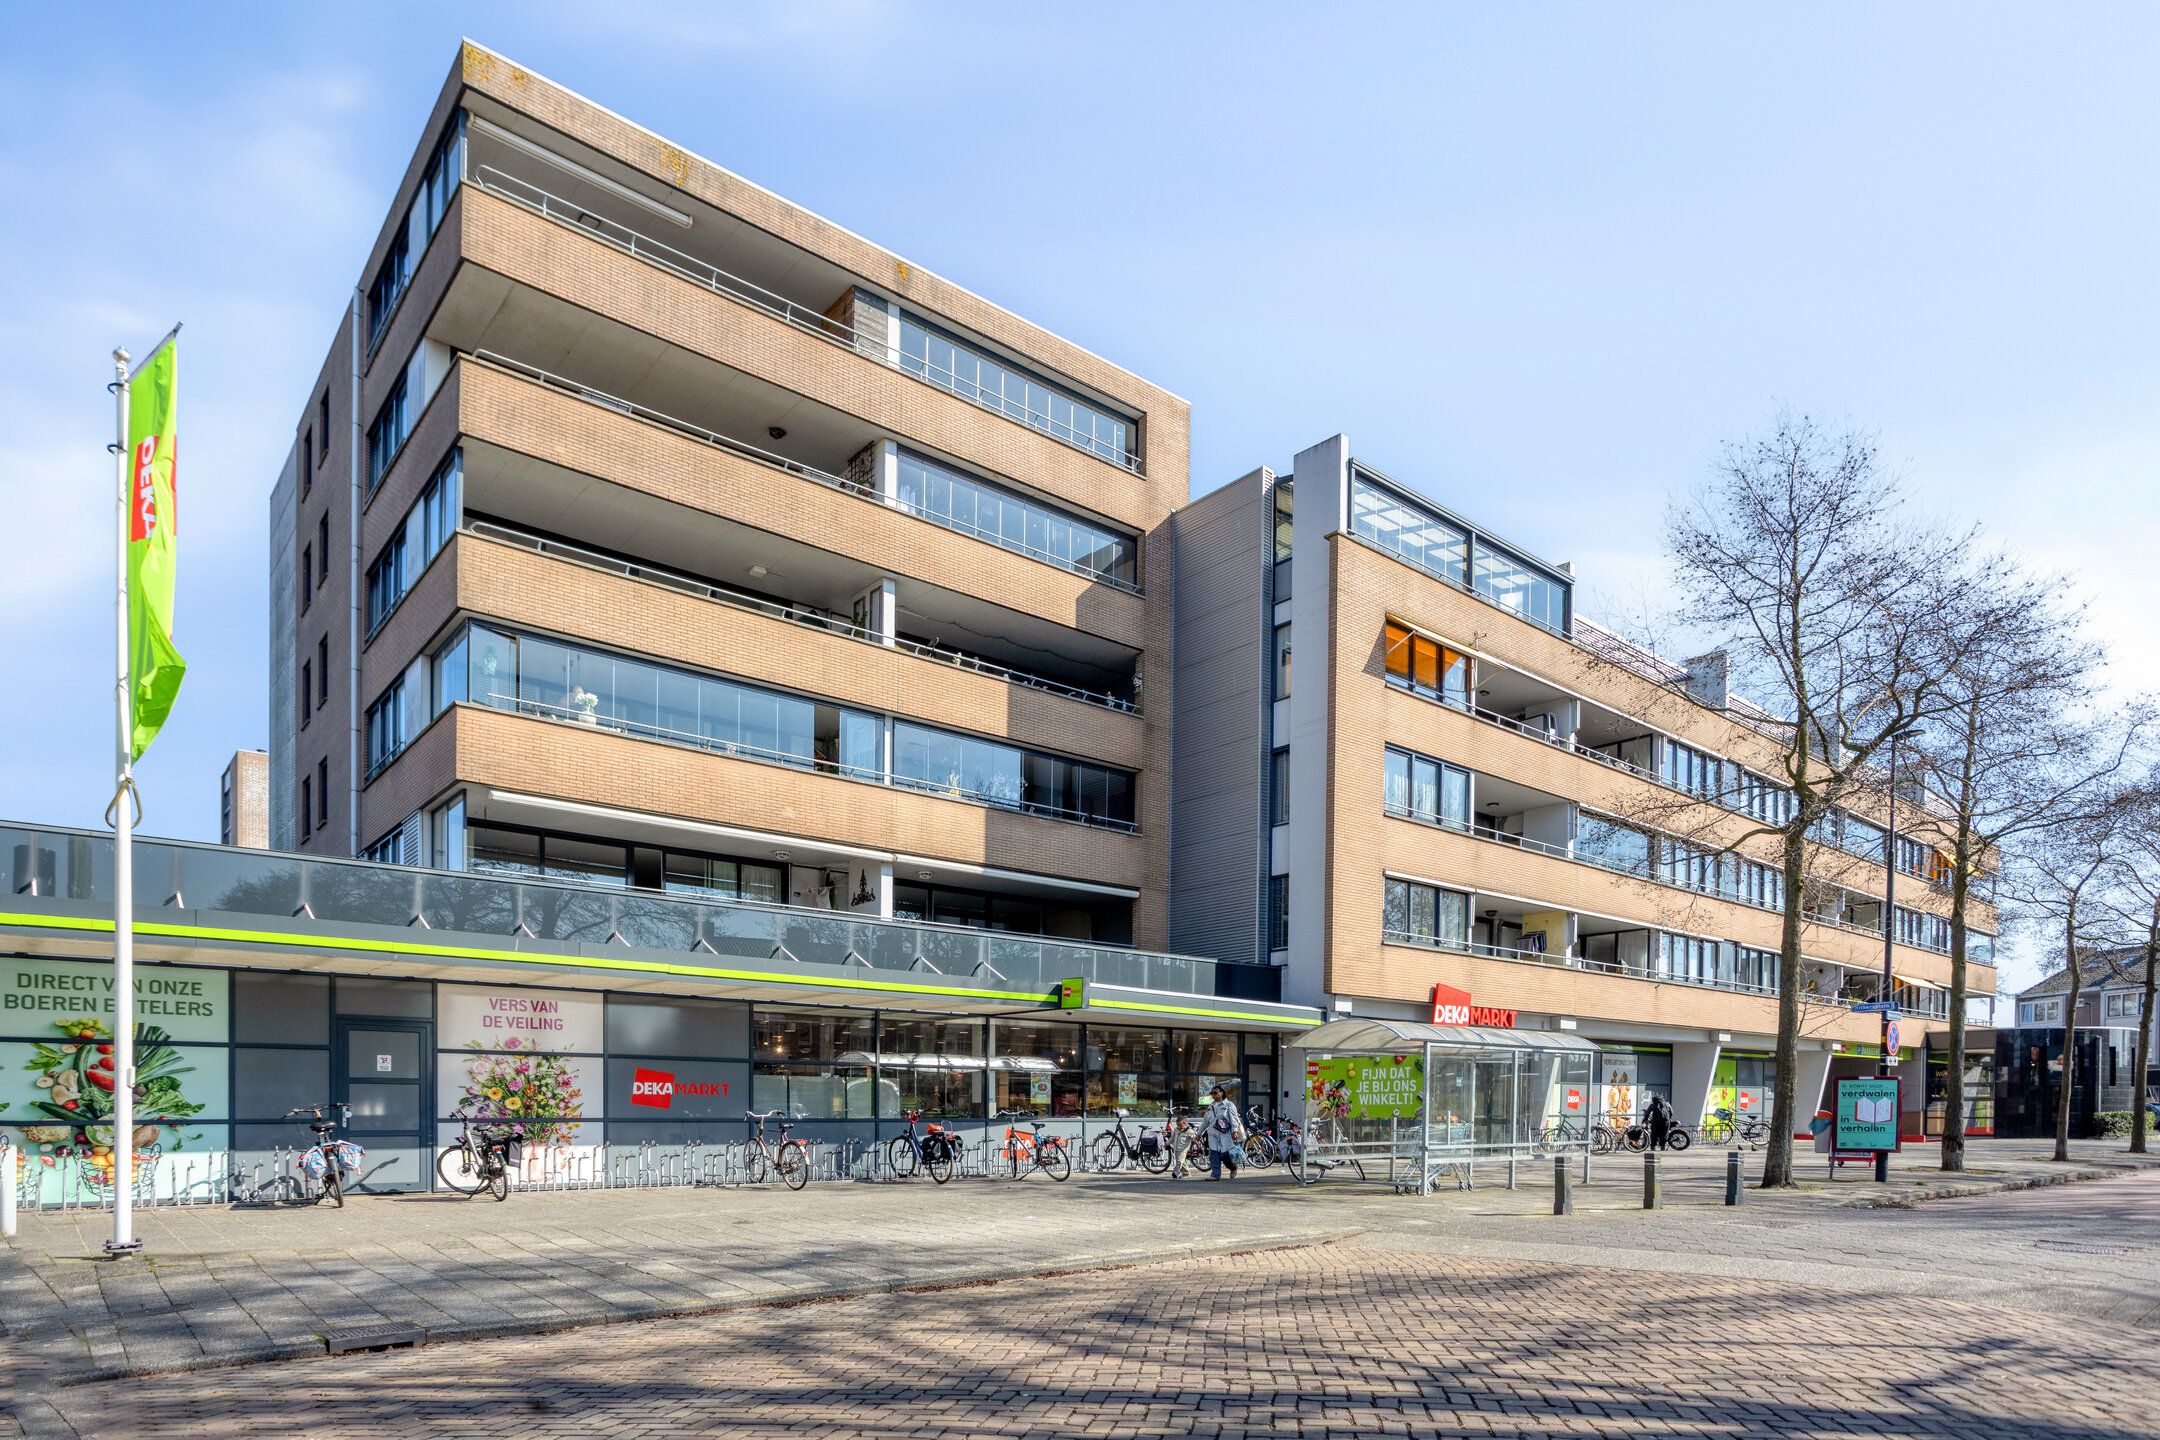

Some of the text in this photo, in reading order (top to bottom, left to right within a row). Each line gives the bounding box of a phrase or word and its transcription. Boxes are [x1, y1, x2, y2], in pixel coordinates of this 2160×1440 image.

[16, 972, 204, 996] DIRECT VN ONZE
[3, 993, 97, 1012] BOEREN
[136, 999, 214, 1016] TELERS
[488, 998, 558, 1013] VERS VAN
[482, 1015, 563, 1031] DE VEILING
[1362, 1067, 1411, 1080] FIJN DAT
[631, 1081, 730, 1097] DEKAMARKT
[1357, 1080, 1417, 1093] JE BIJ ONS
[1359, 1093, 1413, 1105] WINKELT!
